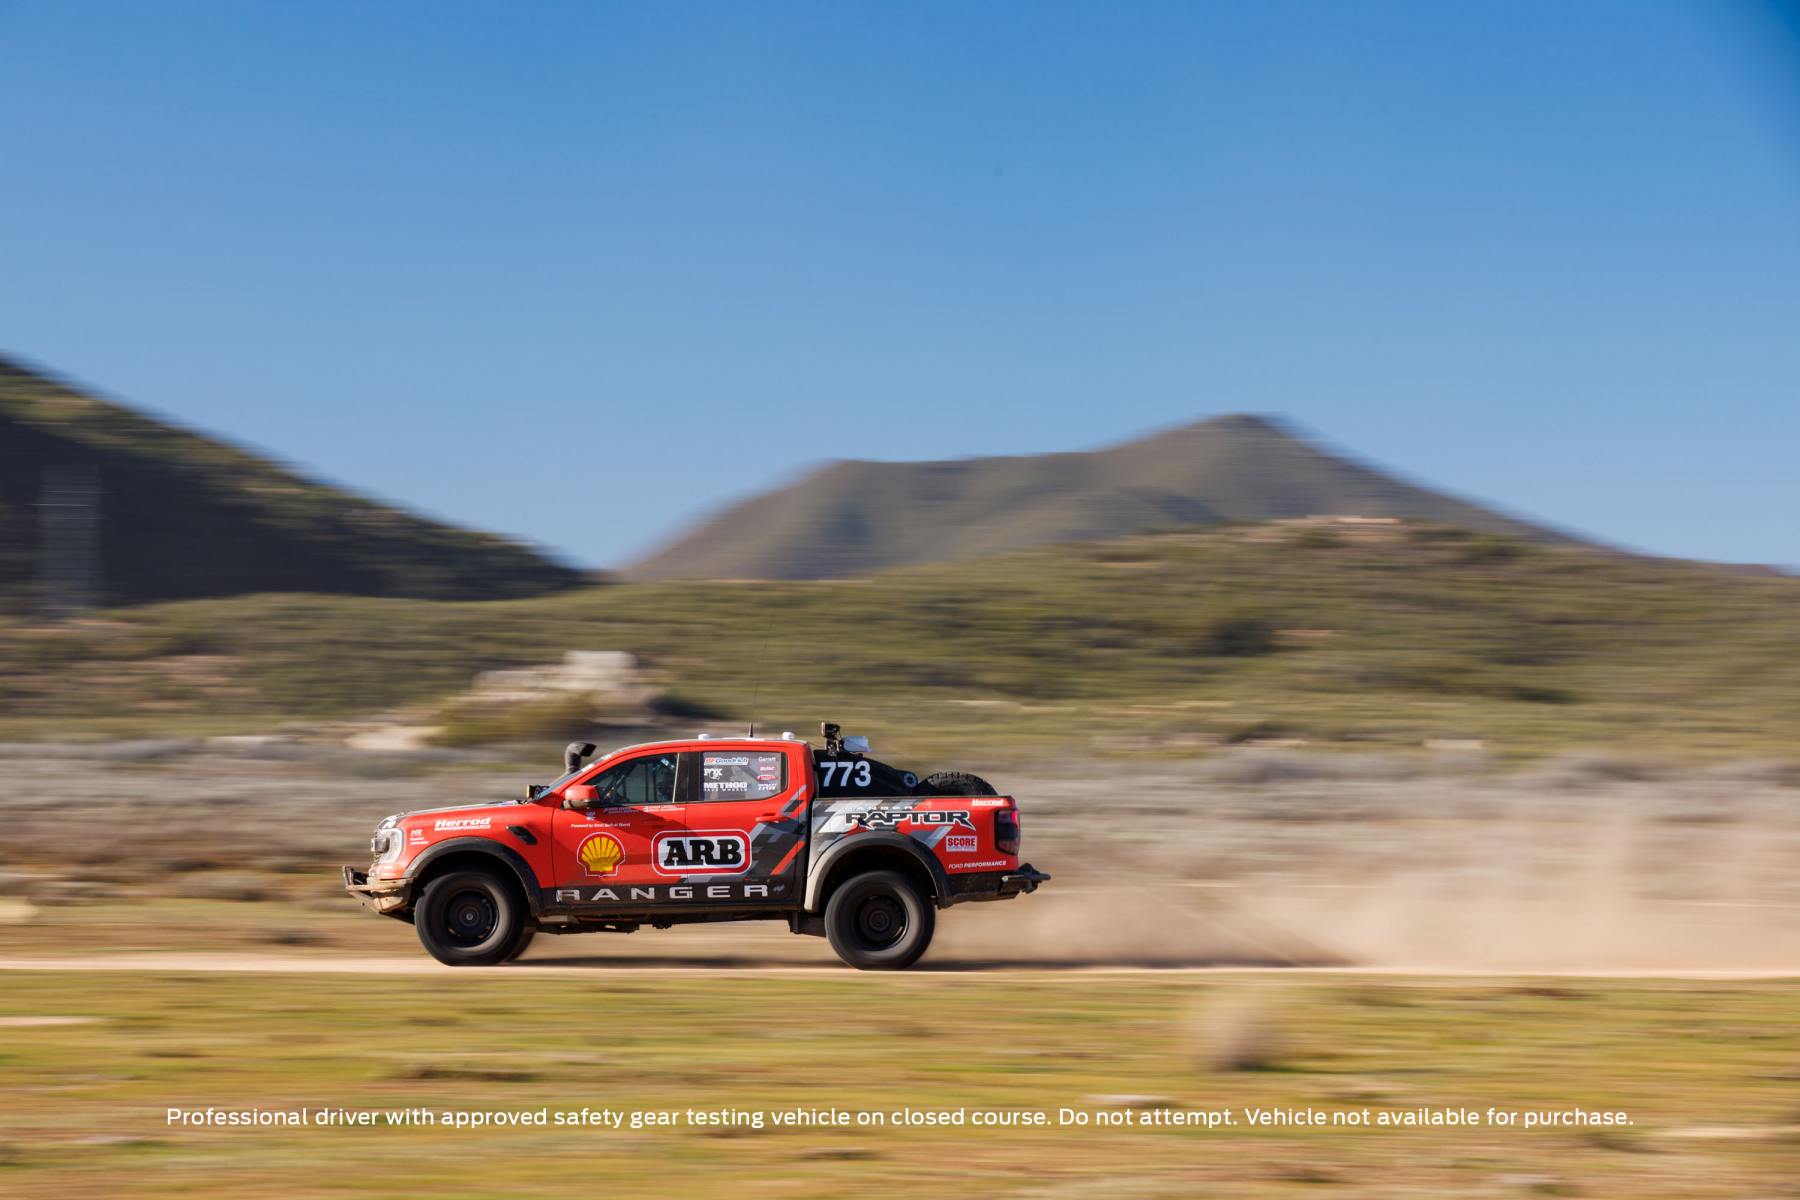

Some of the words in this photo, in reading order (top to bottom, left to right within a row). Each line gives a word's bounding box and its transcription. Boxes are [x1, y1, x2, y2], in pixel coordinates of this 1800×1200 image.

[704, 768, 722, 779] FOX
[820, 760, 871, 787] 773
[434, 817, 491, 827] Herrod
[845, 811, 976, 831] RAPTOR
[947, 837, 976, 846] SCORE
[664, 839, 742, 867] ARB
[964, 860, 1007, 868] PERFORMANCE
[556, 885, 768, 902] RANGER
